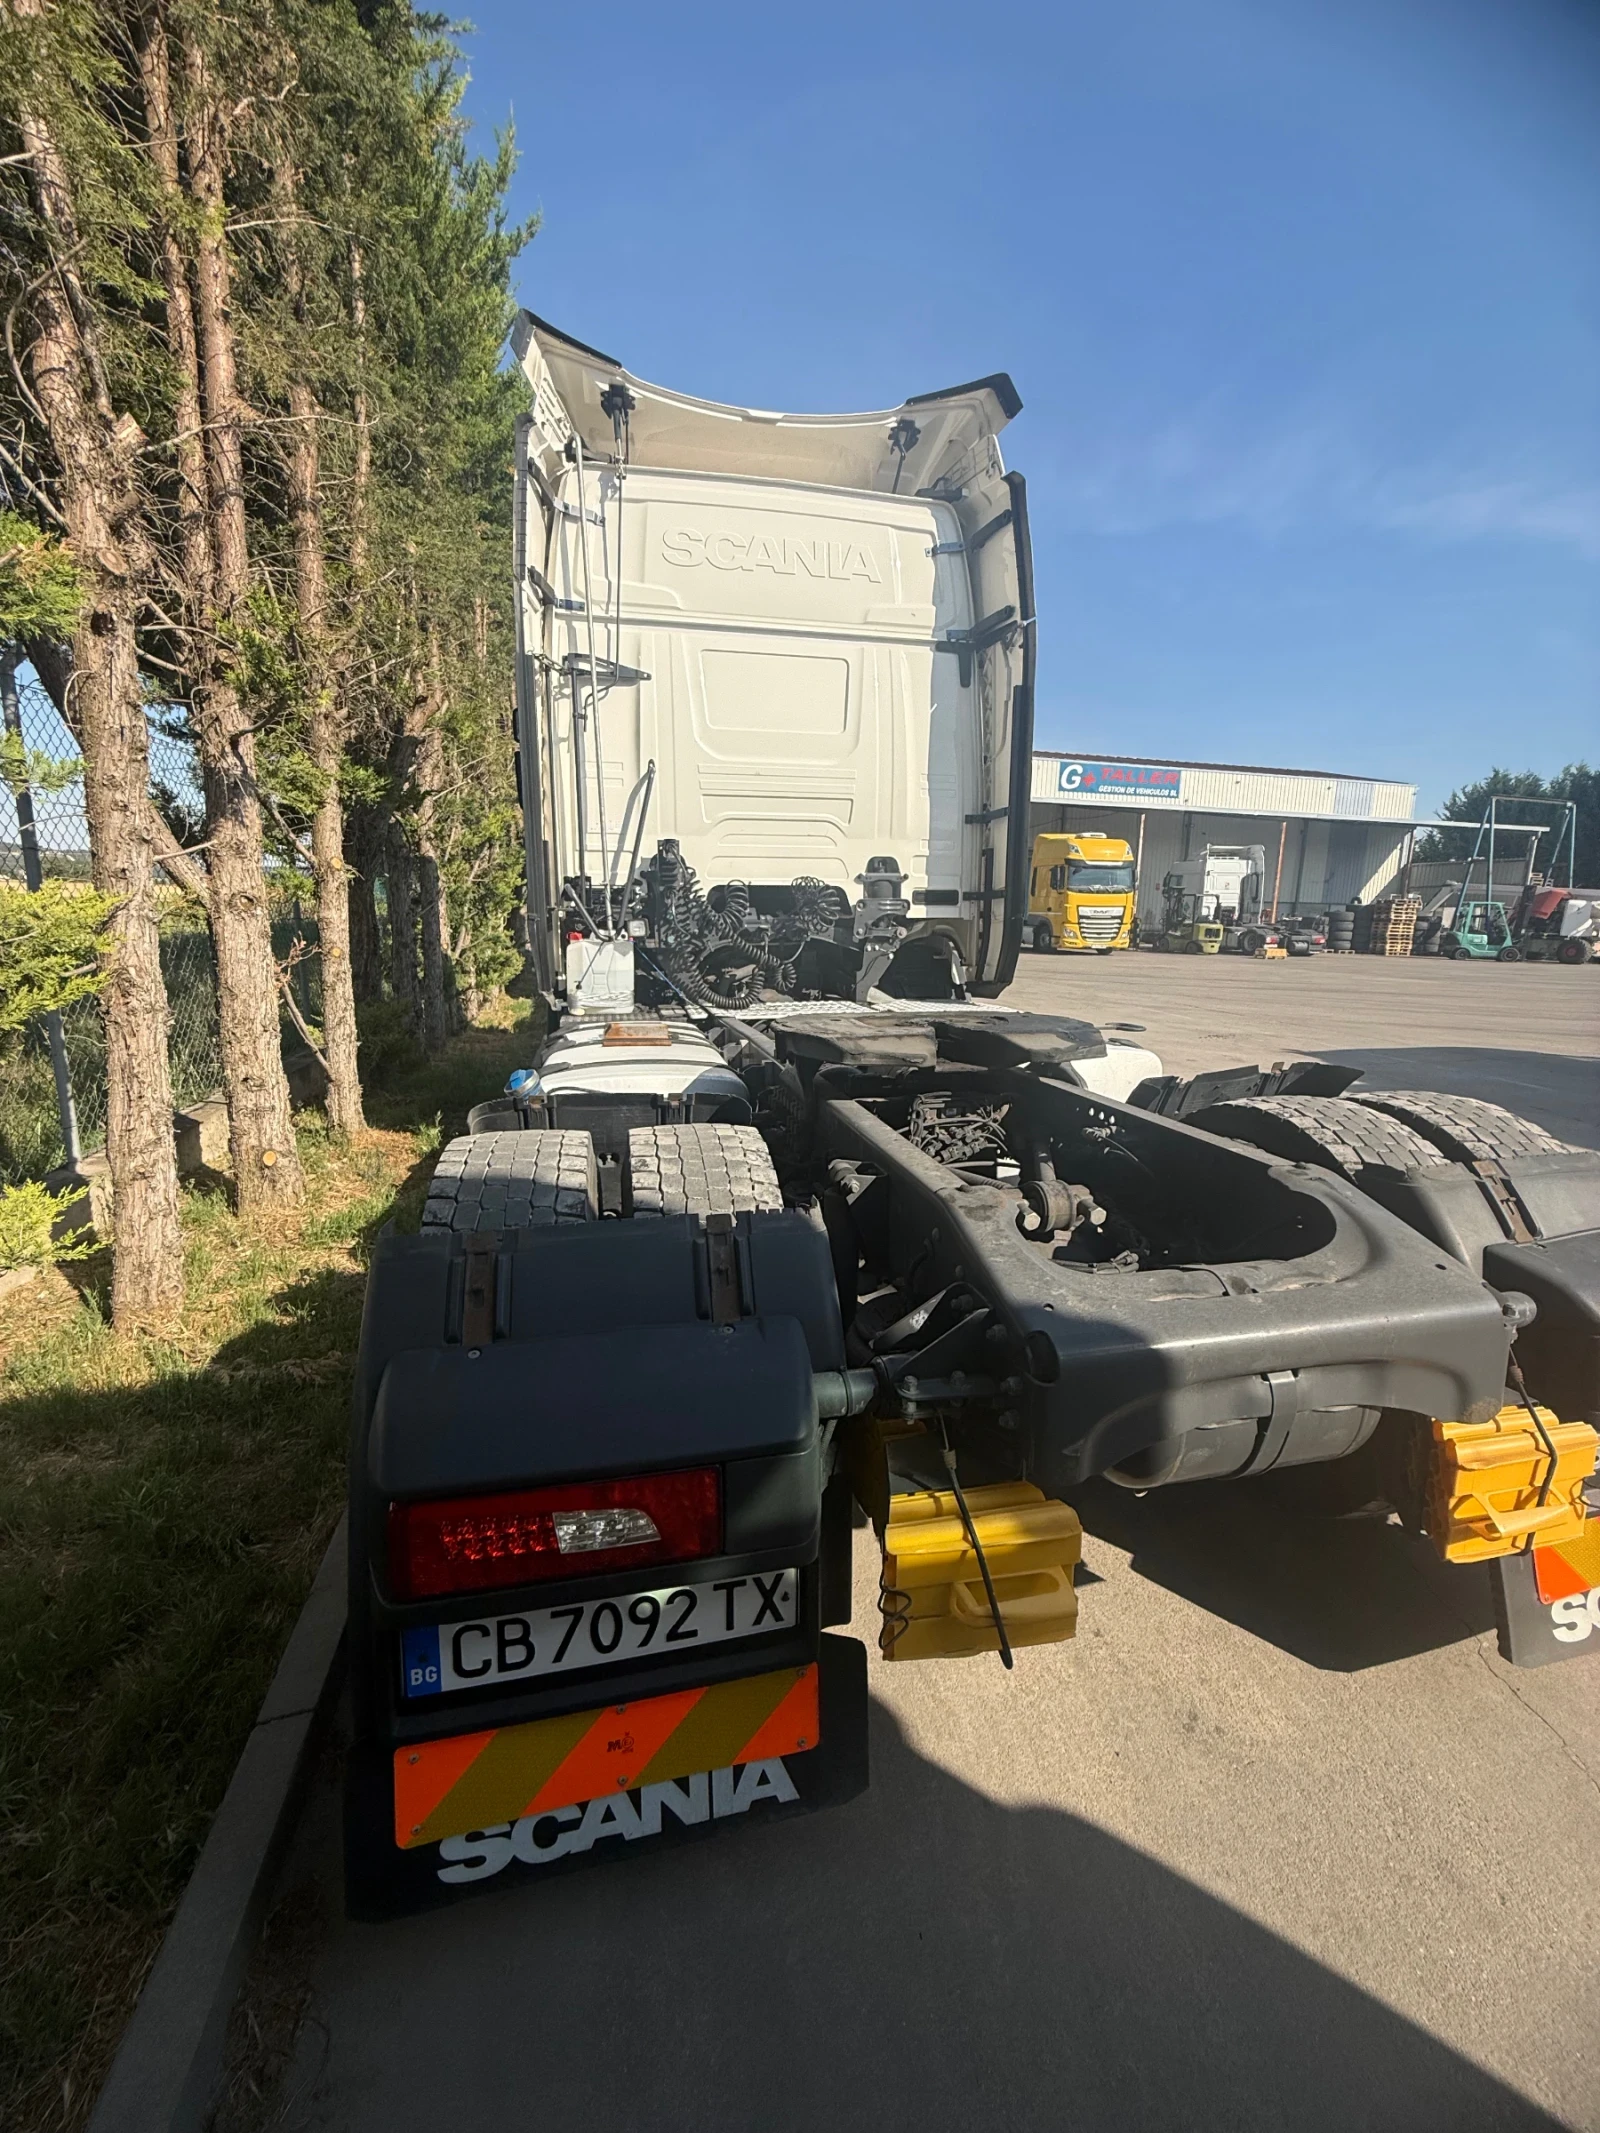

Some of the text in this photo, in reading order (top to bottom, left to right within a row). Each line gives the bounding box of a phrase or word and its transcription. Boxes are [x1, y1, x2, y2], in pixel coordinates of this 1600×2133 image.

[662, 527, 882, 584] SCANIA
[1060, 764, 1084, 790] G
[1101, 767, 1180, 785] TALLER
[1126, 786, 1136, 795] DE
[452, 1572, 785, 1679] CB 7092 TX
[410, 1665, 438, 1686] BG
[437, 1756, 801, 1884] SCANIA
